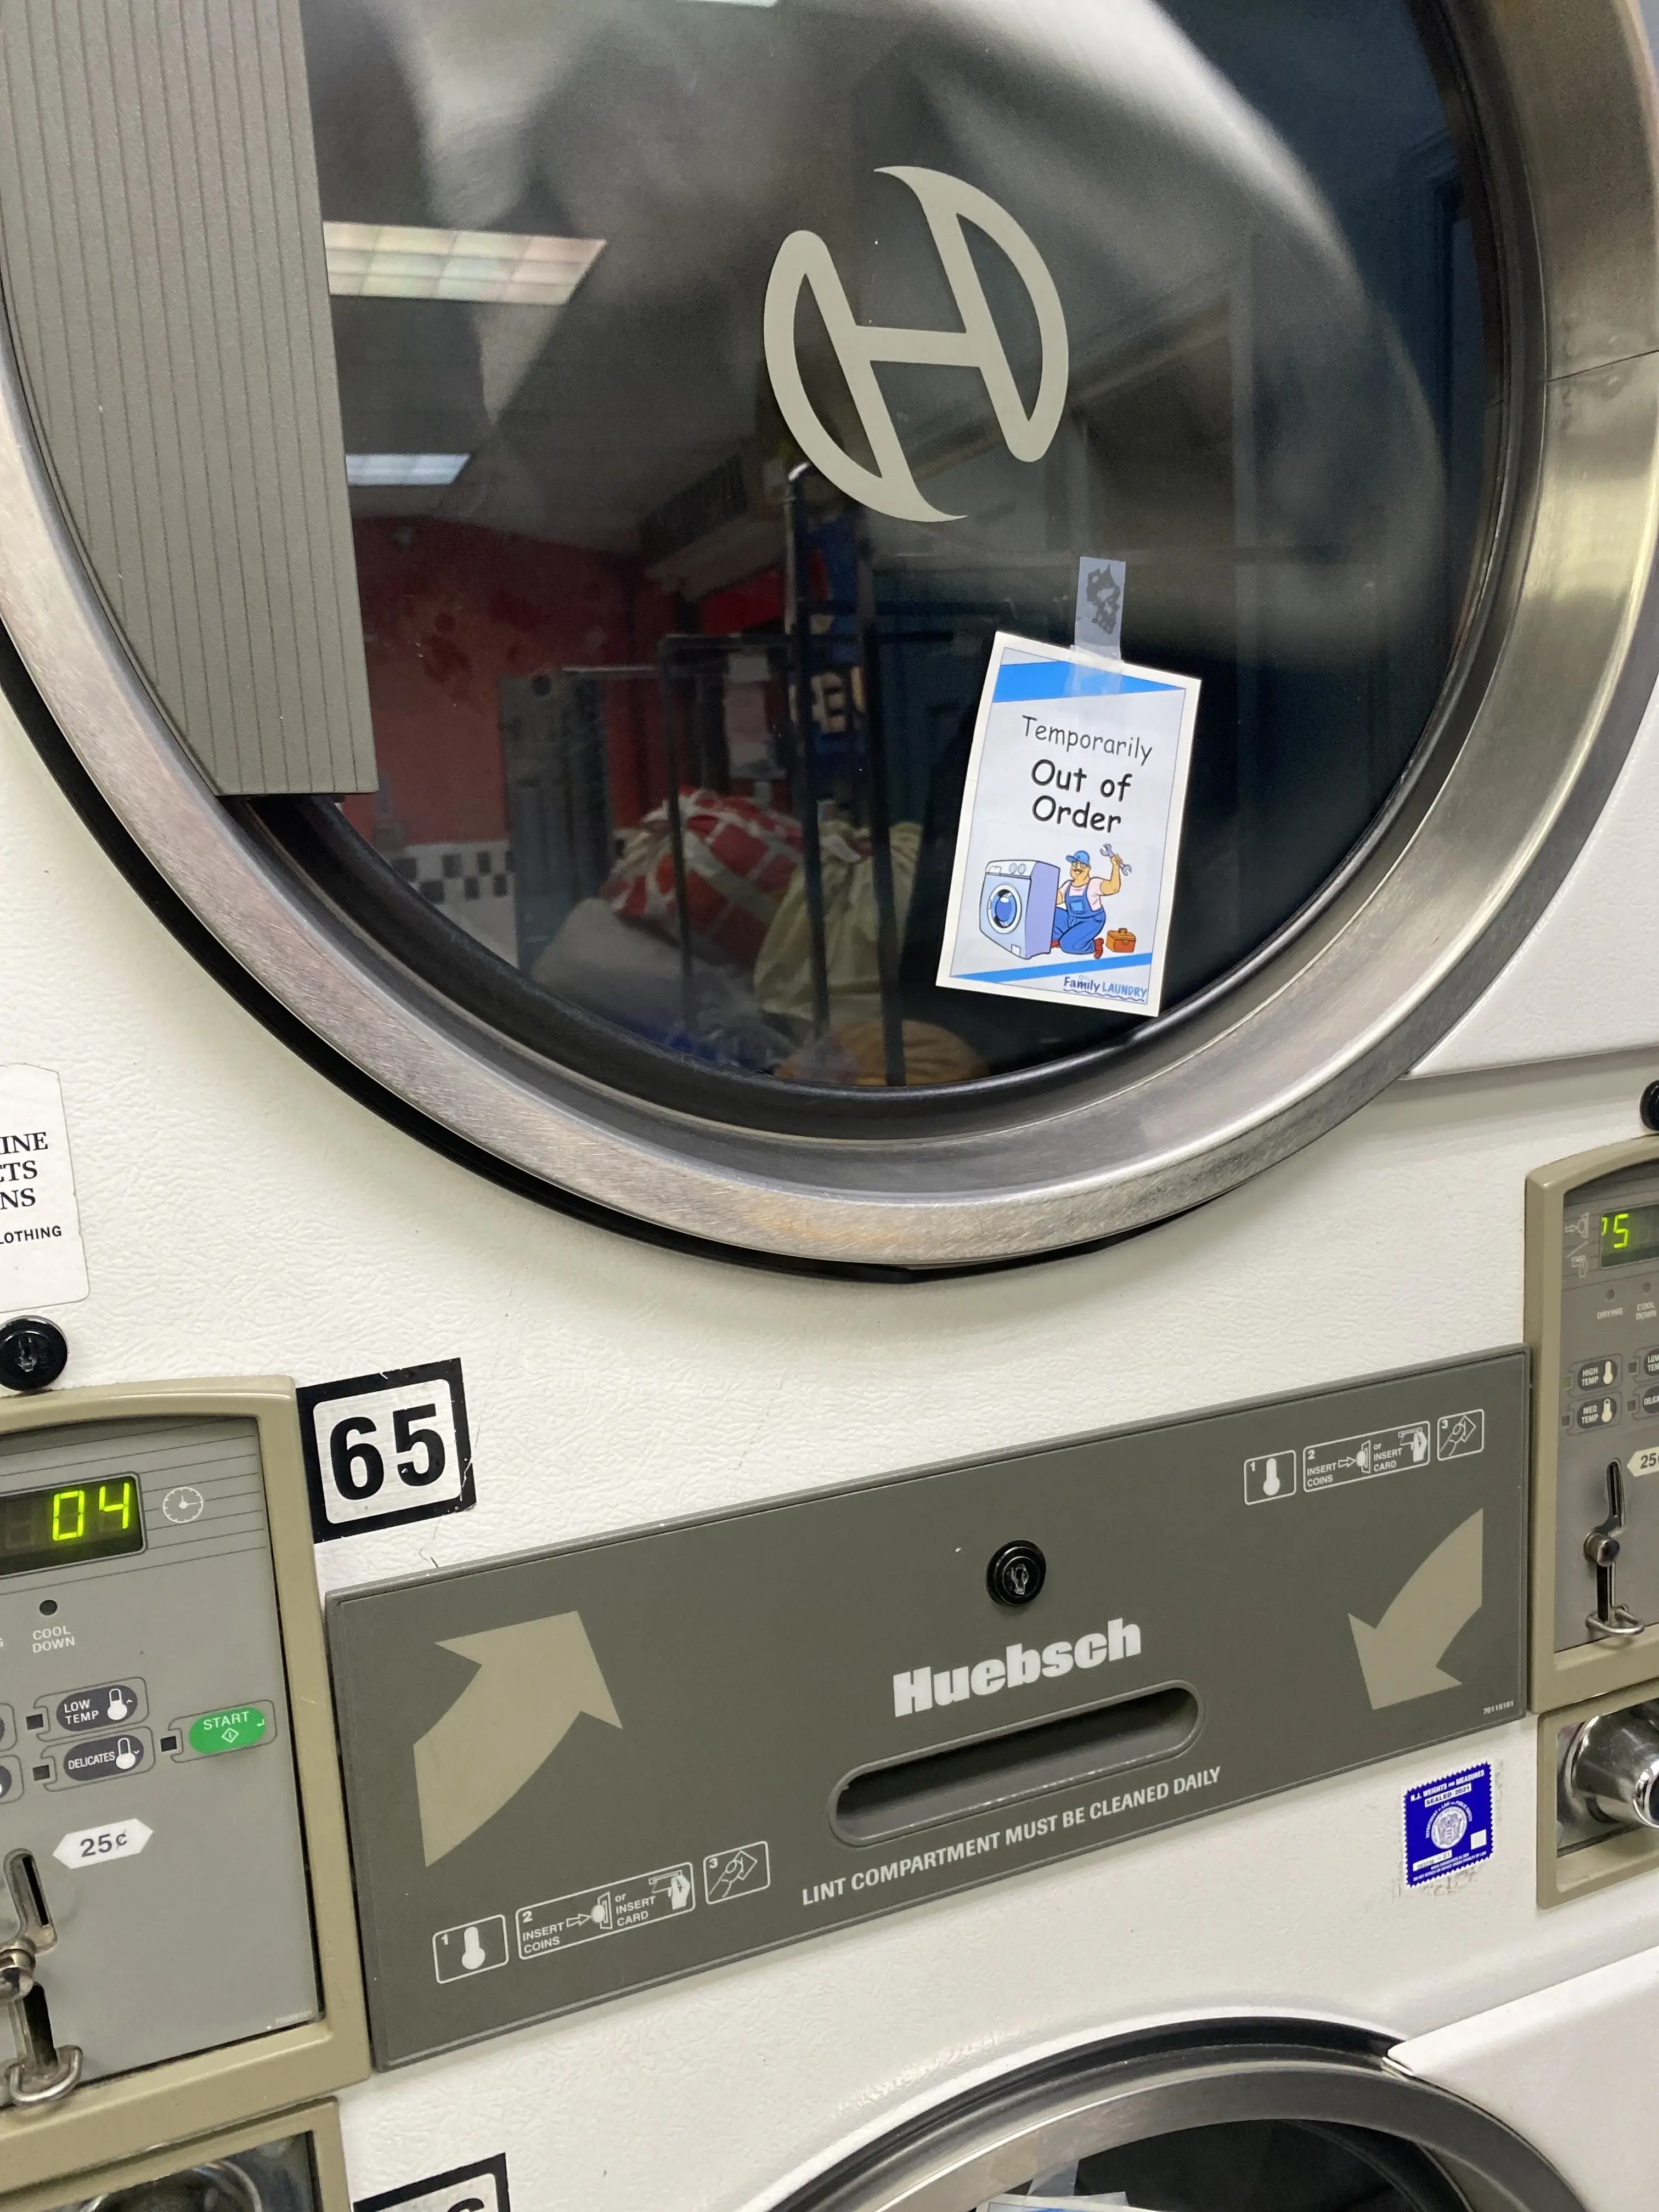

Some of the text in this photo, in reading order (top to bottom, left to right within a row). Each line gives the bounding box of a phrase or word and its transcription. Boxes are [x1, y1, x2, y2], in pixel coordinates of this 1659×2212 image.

[1022, 715, 1152, 766] Temporarily
[1031, 759, 1131, 802] Out of
[1032, 795, 1120, 833] Order
[1064, 976, 1148, 998] Family LAUNDRY
[1597, 1307, 1623, 1319] DRYING
[1637, 1302, 1655, 1312] COOL
[1635, 1310, 1657, 1321] DOWN
[1582, 1367, 1598, 1377] HIGH
[1581, 1376, 1599, 1386] TEMP
[1583, 1405, 1597, 1415] MED
[1441, 1420, 1449, 1429] 3
[1581, 1413, 1599, 1424] TEMP
[330, 1404, 445, 1500] 65
[1373, 1442, 1381, 1451] or
[1307, 1449, 1316, 1460] 2
[1373, 1448, 1403, 1462] INSERT
[1640, 1453, 1659, 1469] 25
[1250, 1462, 1256, 1472] 1
[1307, 1463, 1337, 1476] INSERT
[1373, 1460, 1397, 1472] CARD
[1307, 1475, 1333, 1487] COINS
[52, 1482, 129, 1542] 04
[32, 1626, 71, 1640] COOL
[32, 1636, 75, 1654] DOWN
[893, 1617, 1141, 1718] Huebsch
[64, 1699, 91, 1713] LOW
[65, 1709, 99, 1725] TEMP
[203, 1711, 250, 1730] START
[67, 1751, 115, 1770] DELICATES
[1423, 1782, 1448, 1797] WEIGHTS
[1455, 1769, 1485, 1786] MEASURES
[1426, 1785, 1470, 1805] SEALED 2021
[802, 1767, 1221, 1906] LINT COMPARTMENT MUST BE CLEANED DAILY
[80, 1830, 128, 1858] 25¢
[709, 1858, 718, 1869] 3
[614, 1892, 626, 1903] or
[616, 1896, 656, 1915] INSERT
[522, 1911, 533, 1923] 2
[617, 1910, 649, 1927] CARD
[522, 1922, 565, 1942] INSERT
[441, 1934, 449, 1945] 1
[523, 1936, 560, 1954] COINS
